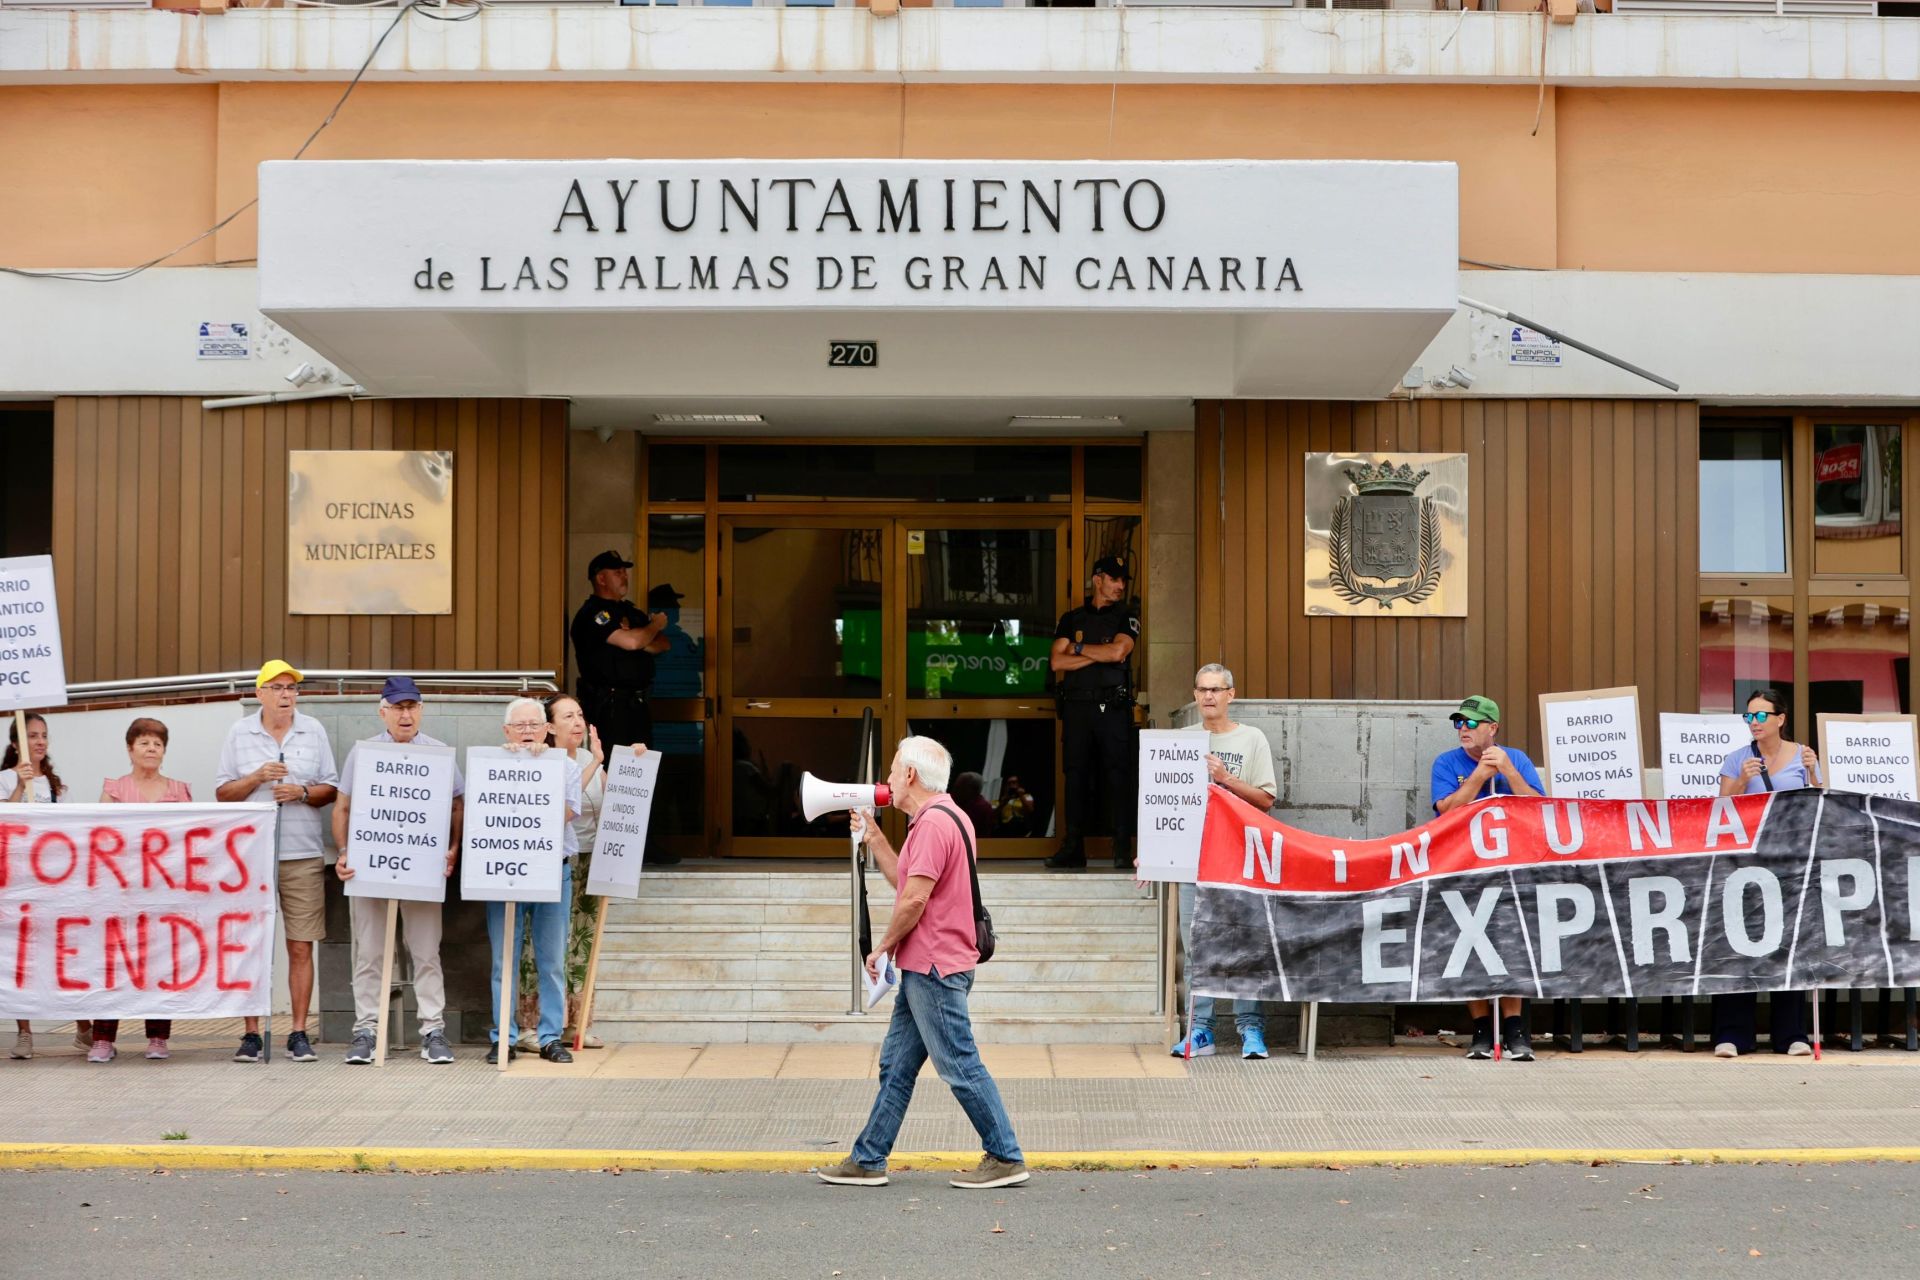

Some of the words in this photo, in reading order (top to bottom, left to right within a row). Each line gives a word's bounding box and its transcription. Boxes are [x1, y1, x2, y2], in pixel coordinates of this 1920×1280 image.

[553, 178, 1166, 233] AYUNTAMIENTO
[414, 257, 454, 291] de
[480, 256, 570, 291] LAS
[594, 256, 790, 291] PALMAS
[816, 256, 878, 291] DE
[905, 256, 1047, 291] GRAN
[1075, 256, 1304, 292] CANARIA
[831, 344, 875, 365] 270
[325, 502, 415, 520] OFICINAS
[305, 543, 436, 561] MUNICIPALES
[0, 601, 45, 616] NTICO
[0, 624, 37, 639] IDOS
[0, 649, 20, 661] OS
[22, 644, 52, 659] MÁS
[1567, 713, 1613, 727] BARRIO
[1556, 735, 1568, 745] EL
[1571, 731, 1627, 744] POLVORIN
[1680, 733, 1731, 744] BARRIO
[1846, 737, 1891, 747] BARRIO
[1150, 749, 1156, 761] 7
[1159, 749, 1199, 761] PALMAS
[1568, 750, 1617, 763] UNIDOS
[1669, 753, 1683, 764] EL
[1686, 753, 1728, 765] CARD
[1830, 755, 1863, 765] LOMO
[1866, 755, 1910, 765] BLANCO
[375, 761, 430, 777] BARRIO
[488, 769, 542, 782] BARRIO
[618, 764, 643, 778] BARRIO
[1555, 770, 1601, 783] SOMOS
[1605, 766, 1633, 780] MÁS
[1154, 772, 1194, 784] UNIDOS
[1847, 773, 1895, 784] UNIDOS
[370, 784, 385, 797] EL
[389, 785, 431, 801] RISCO
[607, 783, 618, 793] SAN
[618, 785, 649, 798] FRANCISCO
[477, 792, 551, 806] ARENALES
[1145, 794, 1179, 806] SOMOS
[1181, 792, 1202, 806] MÁS
[370, 808, 427, 824] UNIDOS
[612, 803, 635, 815] UNIDOS
[485, 815, 542, 829] UNIDOS
[602, 820, 624, 833] SOMOS
[624, 822, 639, 835] MÁS
[1155, 817, 1185, 831] LPGC
[355, 829, 404, 845] SOMOS
[407, 832, 437, 848] MÁS
[471, 838, 520, 850] SOMOS
[523, 837, 553, 851] MÁS
[1243, 796, 1750, 884] NINGUNA
[602, 841, 625, 857] LPGC
[369, 854, 411, 871] LPGC
[486, 861, 528, 876] LPGC
